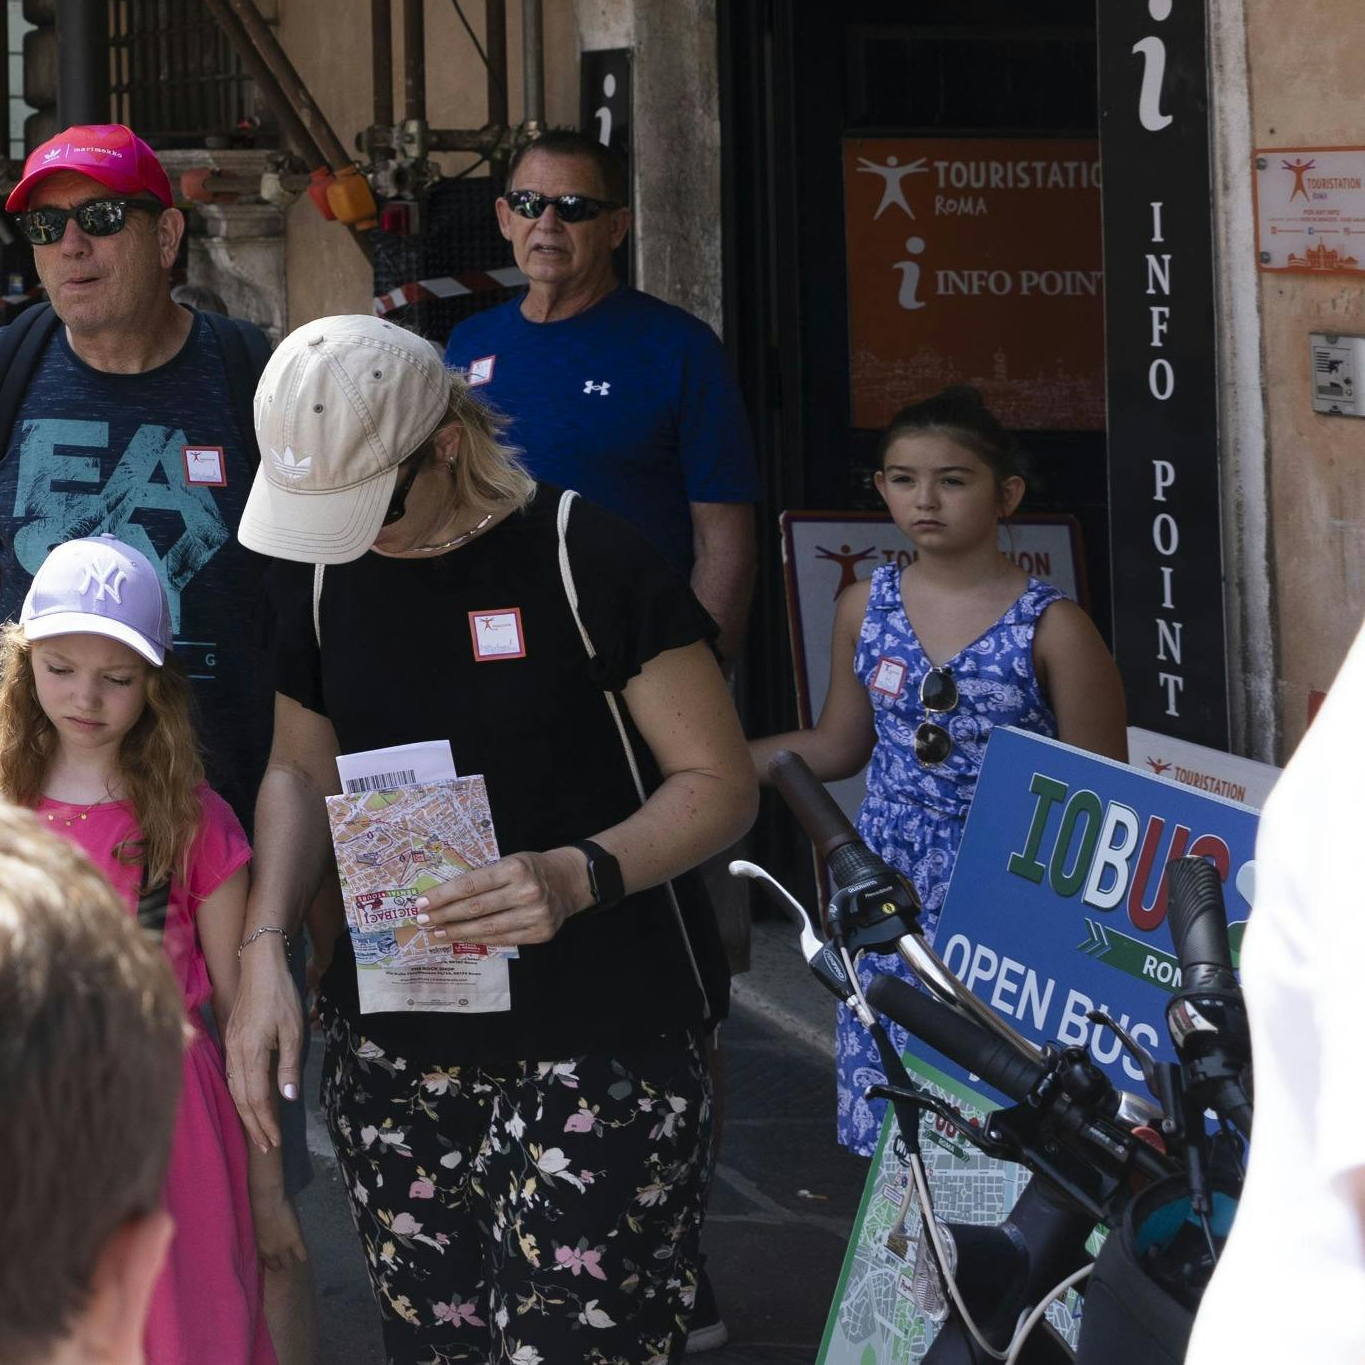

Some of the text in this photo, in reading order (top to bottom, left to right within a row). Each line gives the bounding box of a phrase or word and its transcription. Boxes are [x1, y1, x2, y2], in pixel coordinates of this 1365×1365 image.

[934, 194, 988, 216] ROMA
[936, 270, 1012, 295] INFO
[1145, 202, 1185, 718] INFO POINT
[1175, 766, 1246, 803] TOURISTATION
[942, 934, 1055, 1030] OPEN
[1057, 988, 1159, 1081] BUS
